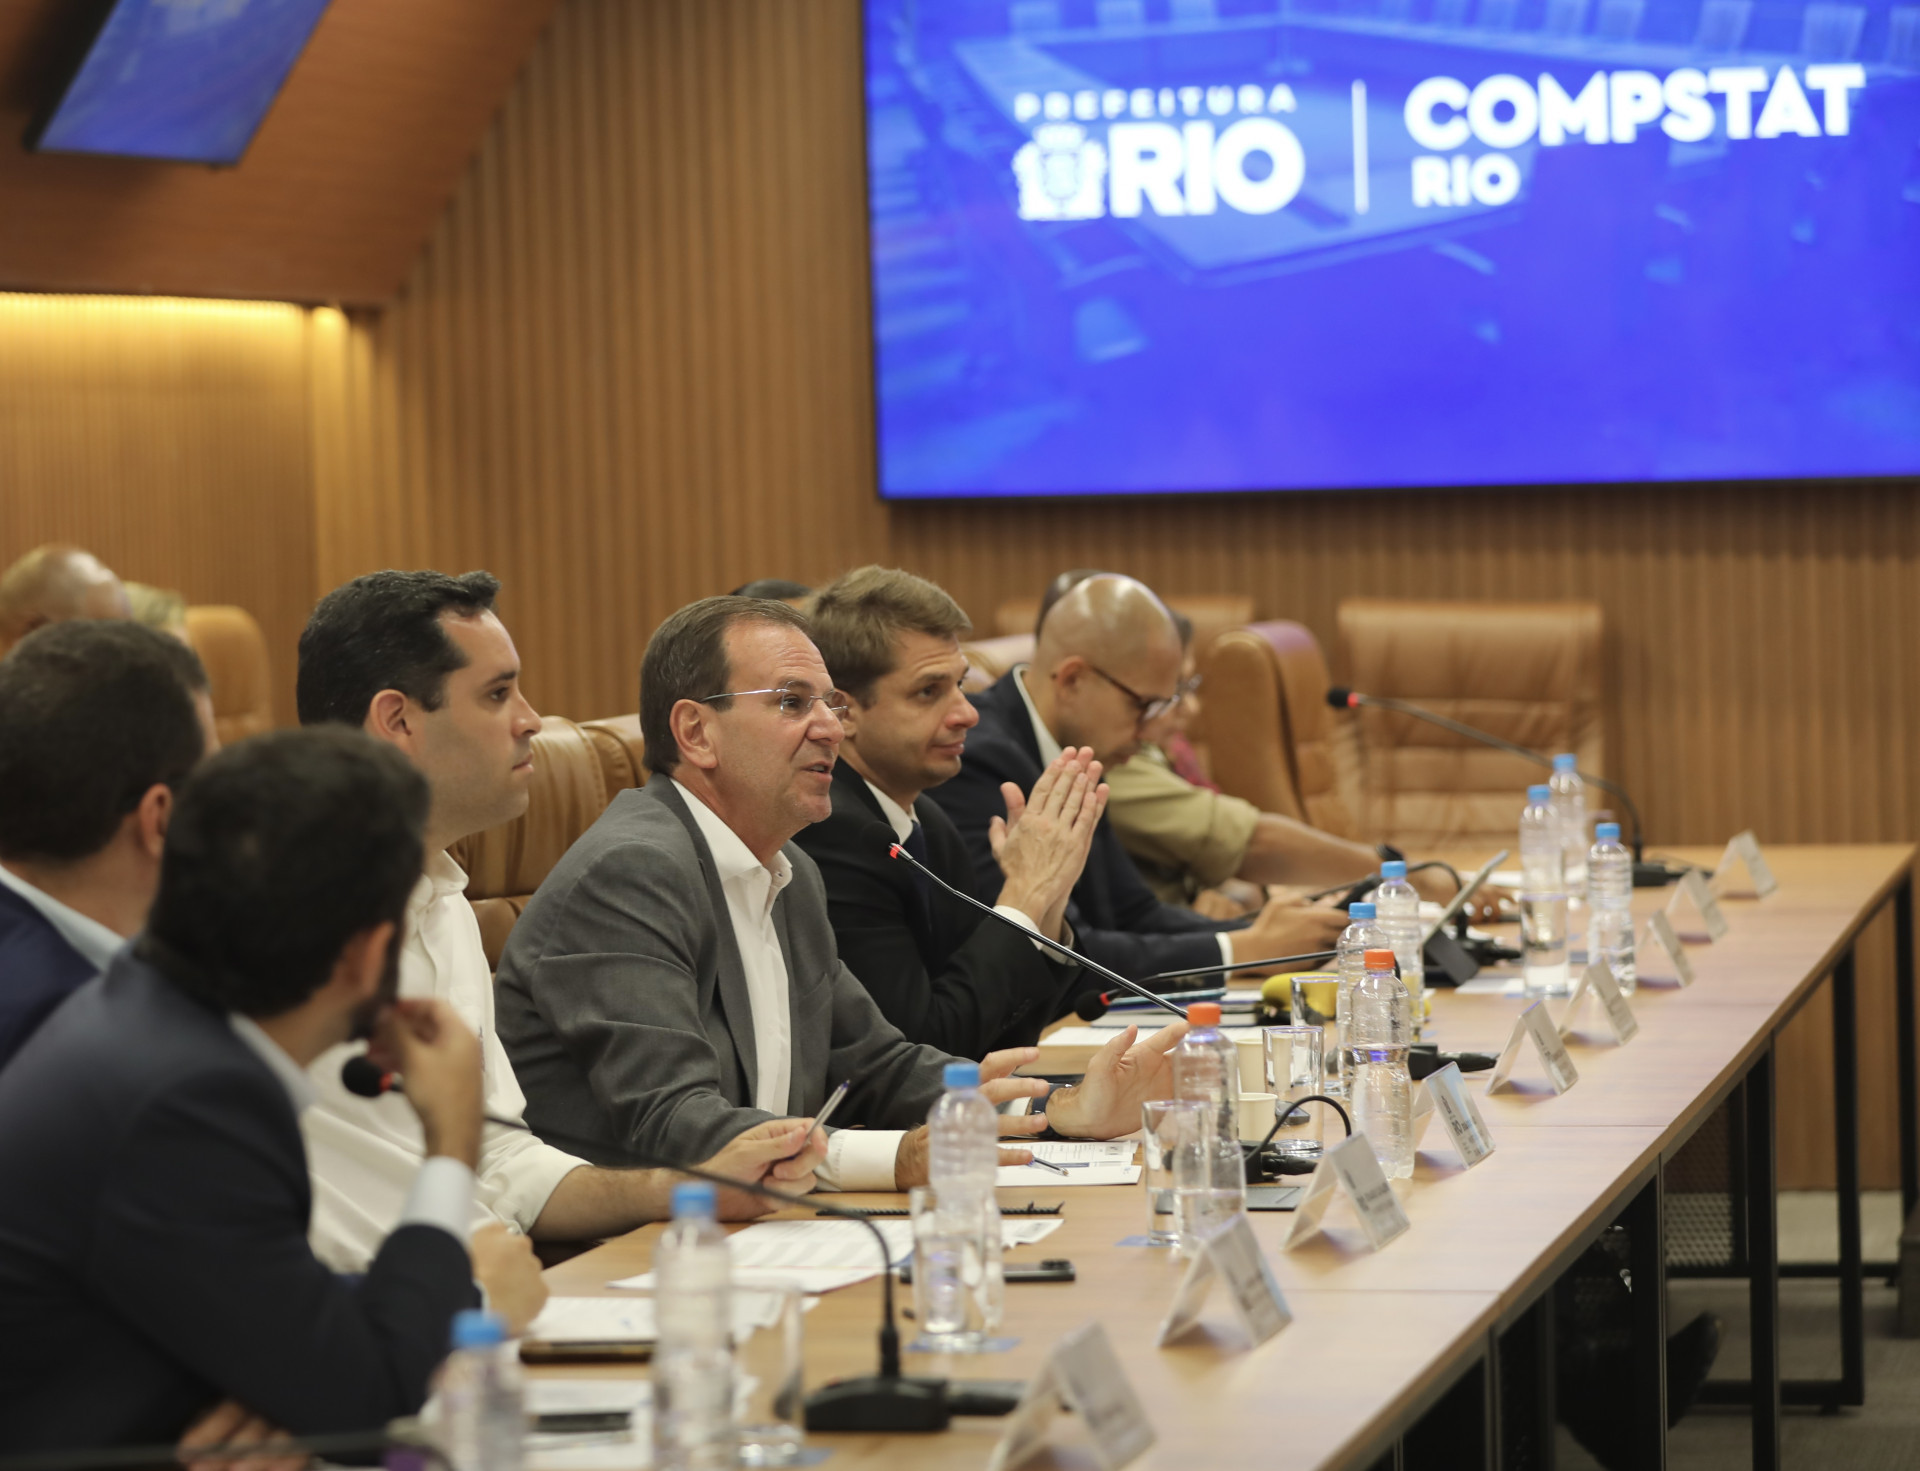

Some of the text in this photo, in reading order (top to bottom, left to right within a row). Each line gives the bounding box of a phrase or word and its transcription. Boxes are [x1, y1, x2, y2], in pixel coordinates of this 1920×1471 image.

[1013, 83, 1298, 122] PREFEITURA
[1404, 63, 1866, 151] COMPSTAT
[1107, 116, 1306, 218] RIO
[1410, 153, 1521, 208] RIO
